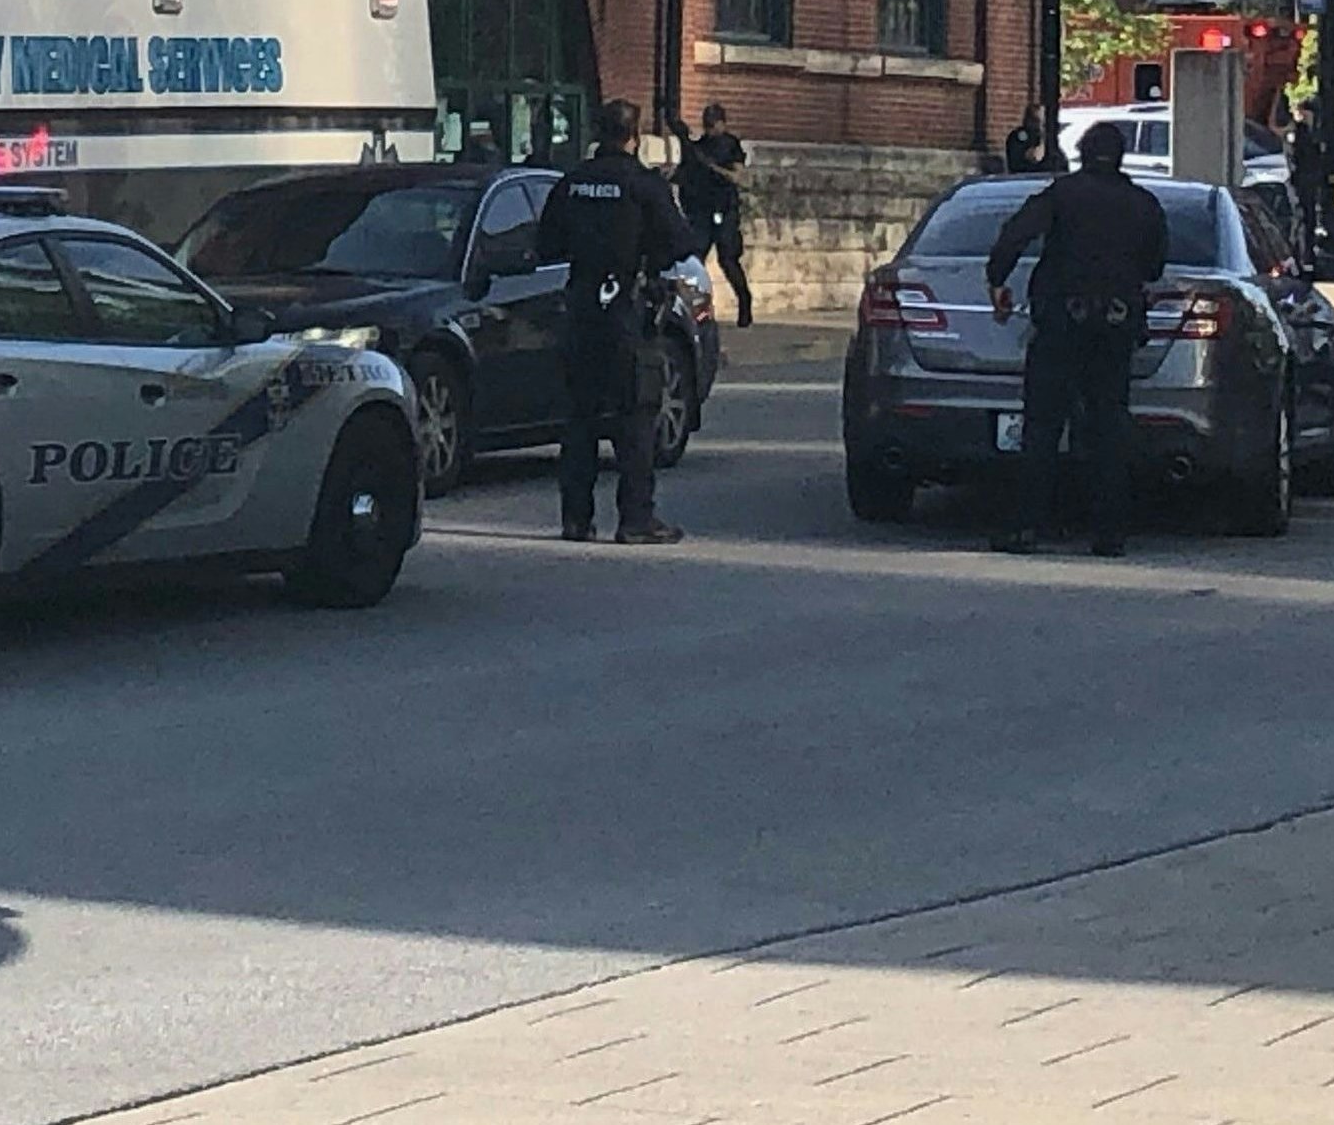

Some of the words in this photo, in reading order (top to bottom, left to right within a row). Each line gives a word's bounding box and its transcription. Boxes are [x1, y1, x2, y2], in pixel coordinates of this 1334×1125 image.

[11, 35, 144, 95] MEDICAL
[148, 35, 283, 95] SERVICES
[11, 140, 78, 168] SYSTEM
[28, 436, 240, 484] POLICE
